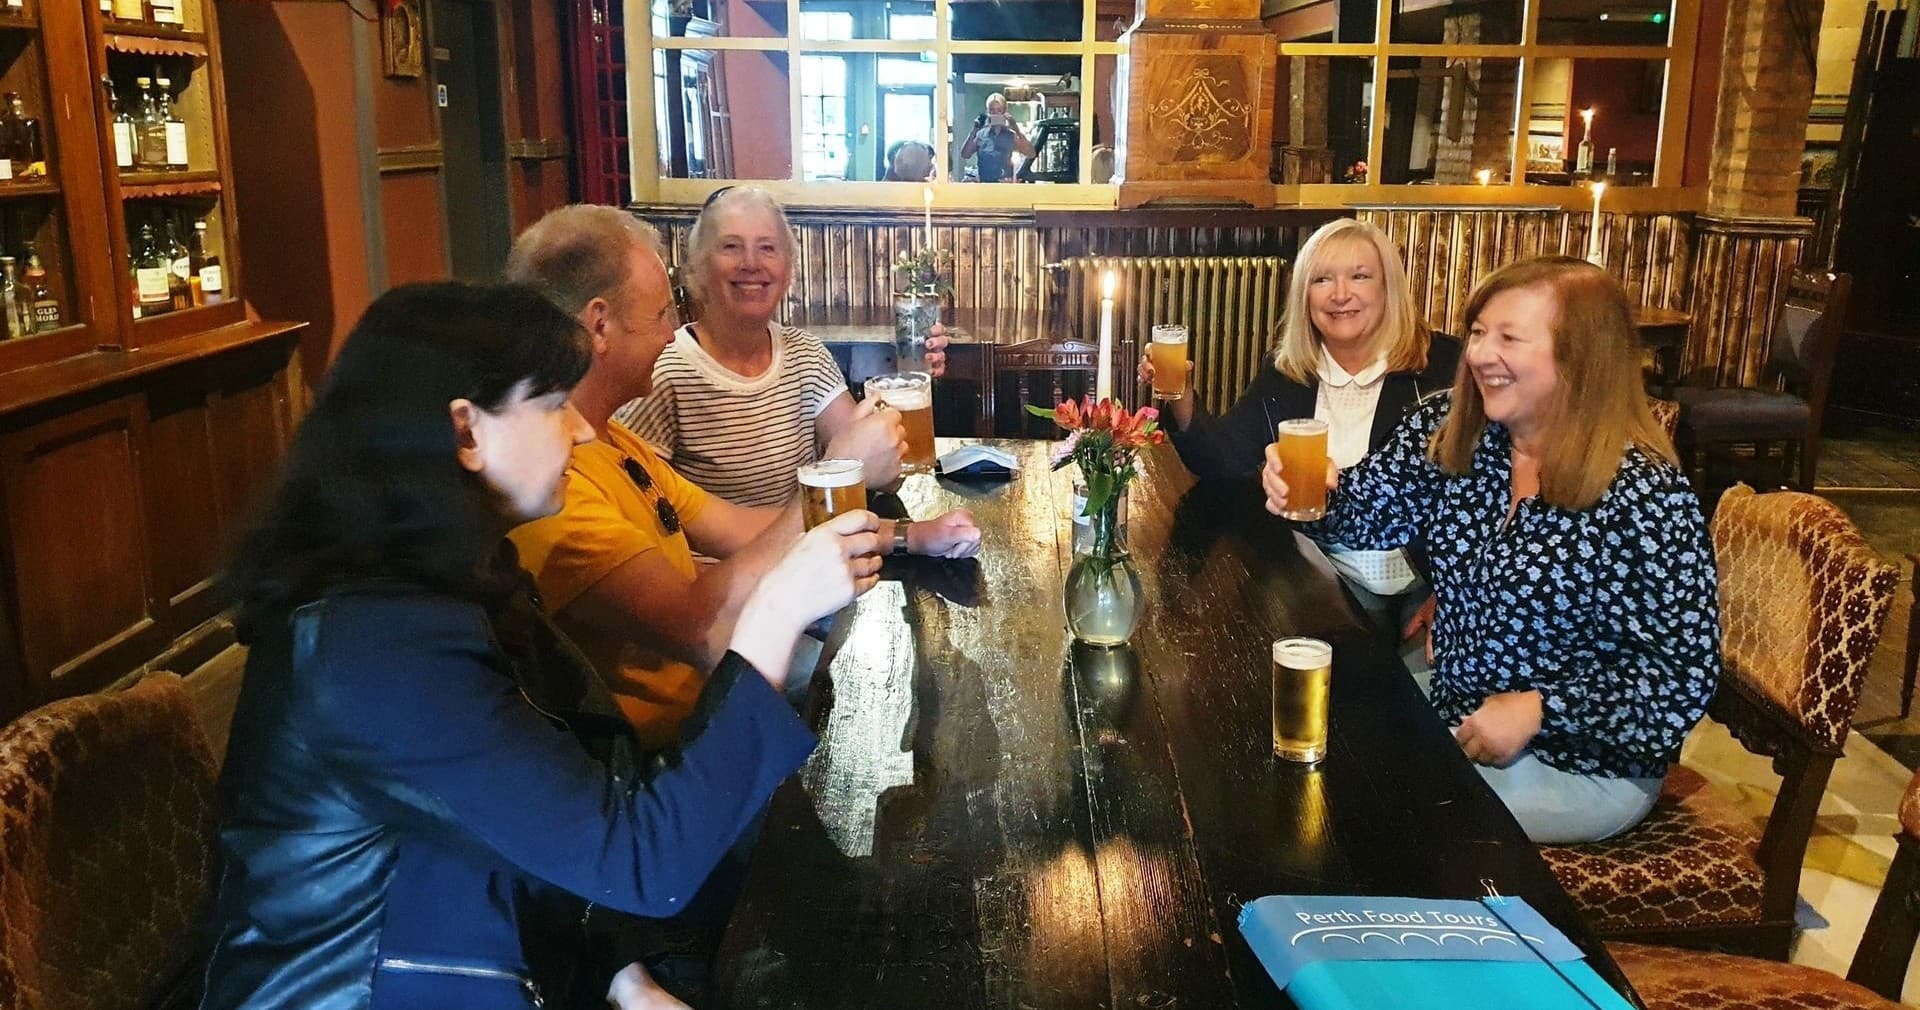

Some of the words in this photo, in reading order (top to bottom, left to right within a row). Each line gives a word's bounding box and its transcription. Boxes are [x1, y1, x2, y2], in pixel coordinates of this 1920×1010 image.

[1295, 909, 1362, 925] Perth
[1362, 909, 1426, 924] Food
[1426, 911, 1498, 927] Tours
